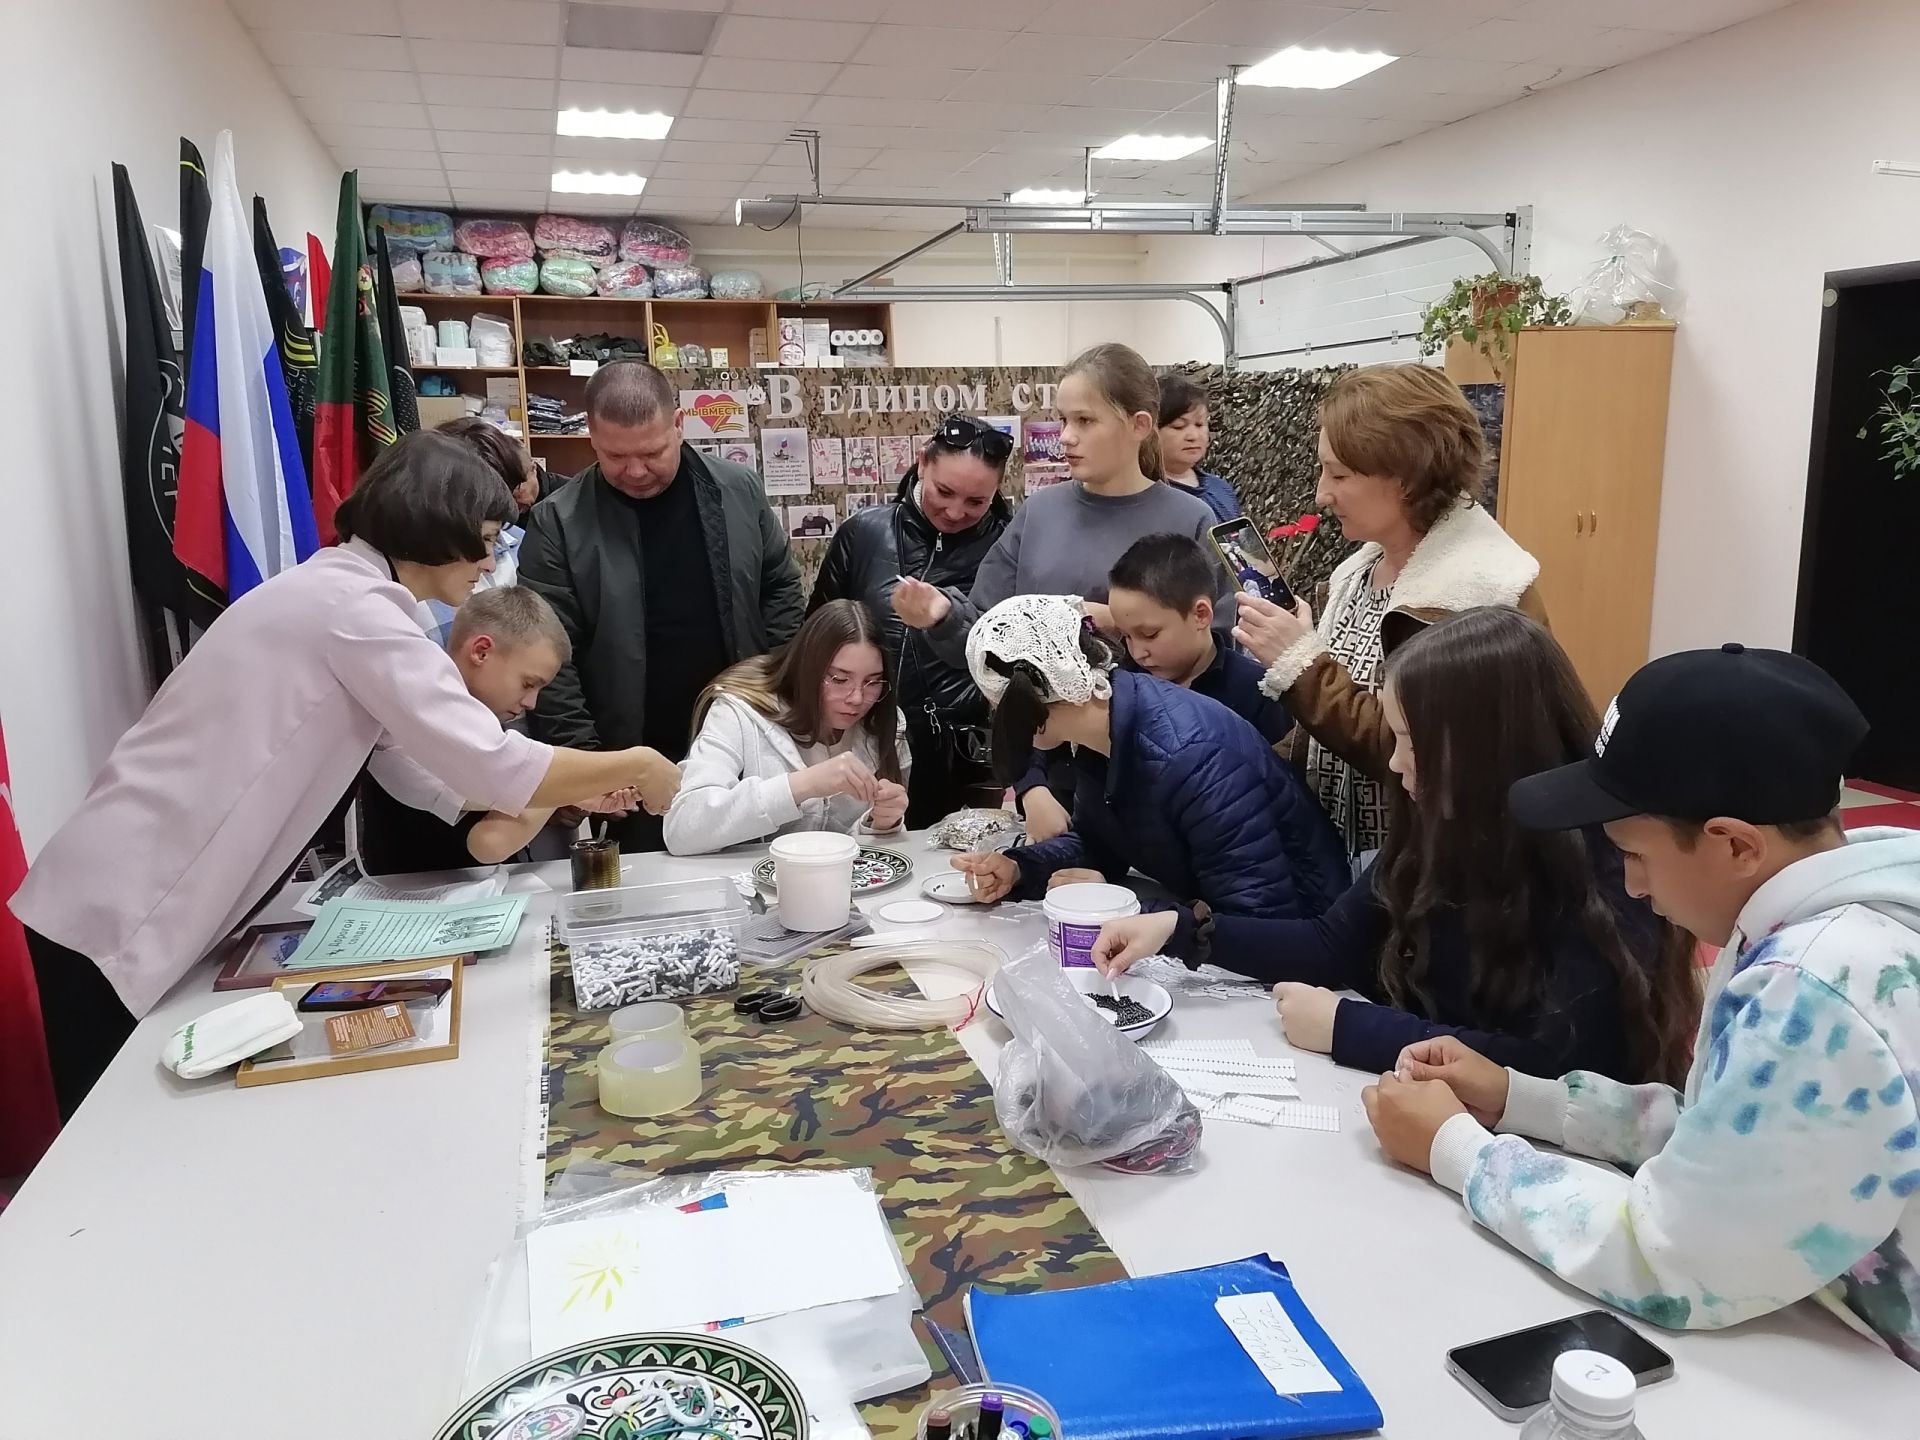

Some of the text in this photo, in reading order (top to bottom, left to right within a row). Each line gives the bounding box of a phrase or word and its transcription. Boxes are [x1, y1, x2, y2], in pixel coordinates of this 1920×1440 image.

[764, 374, 1058, 419] В ЕДИНОМ СТ
[682, 407, 744, 416] МЫВМЕСТЕ
